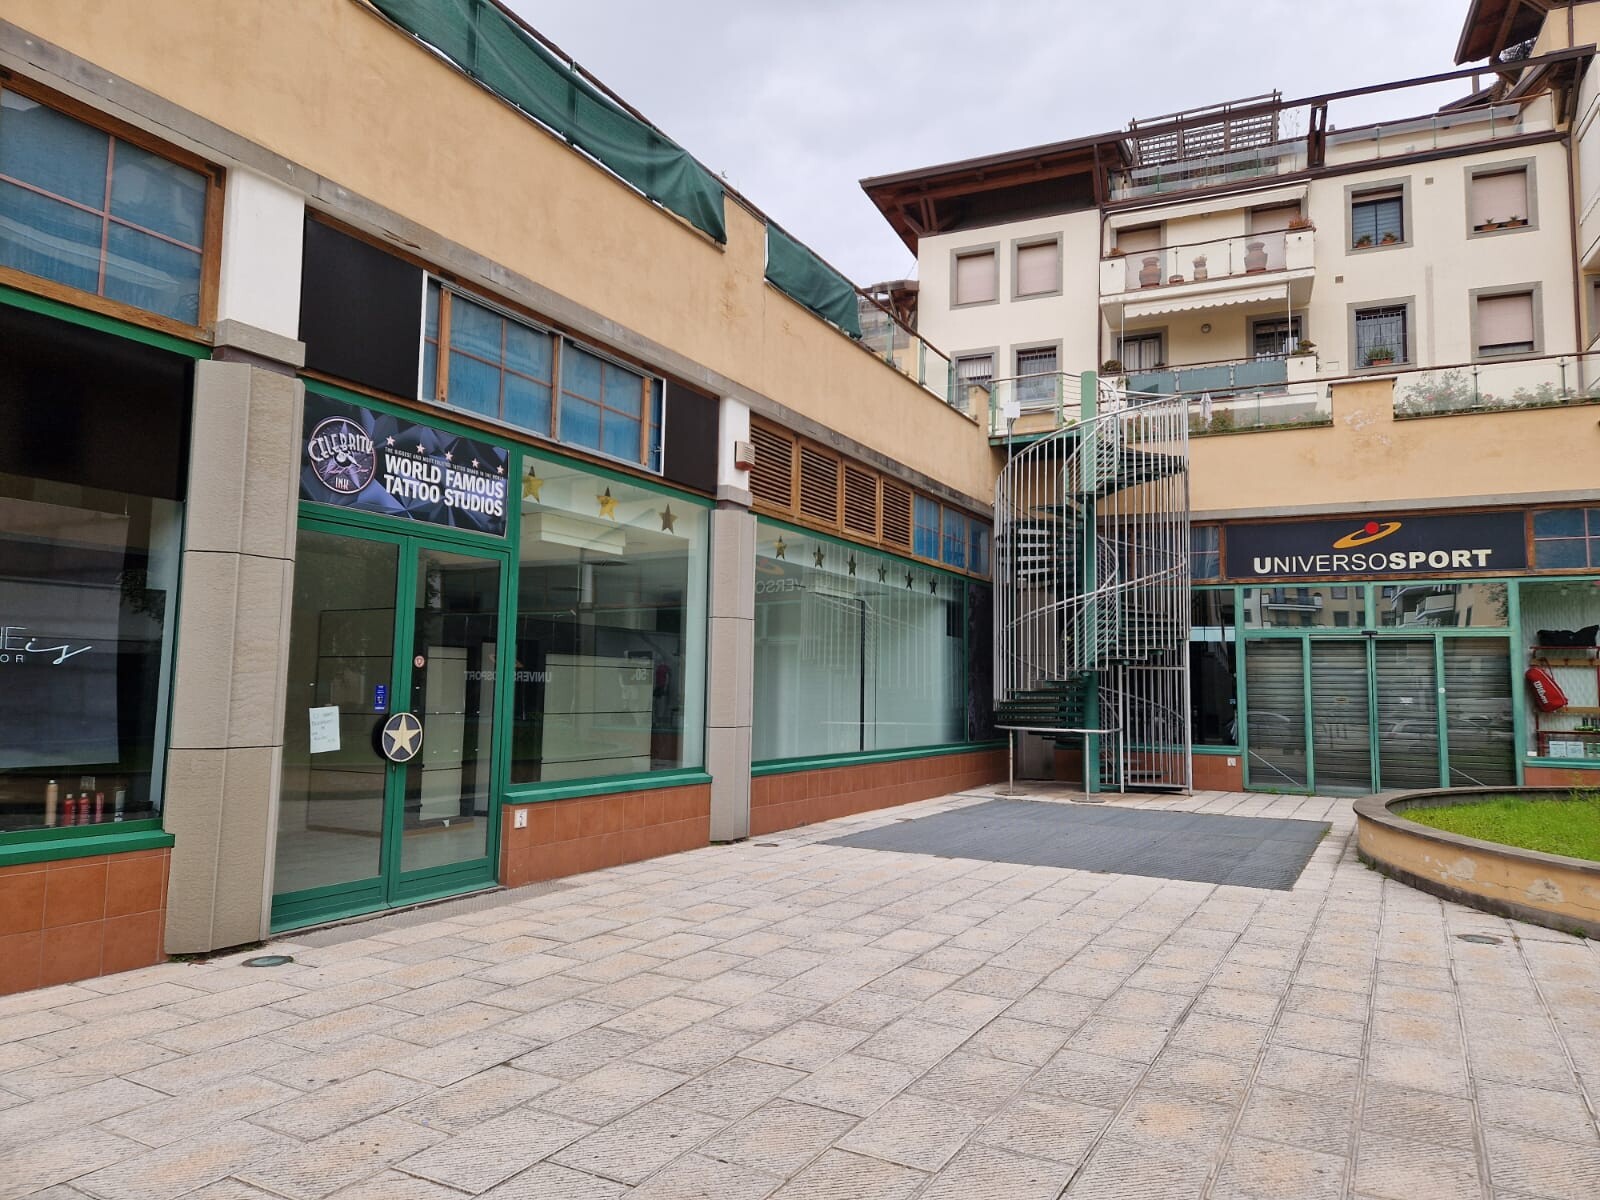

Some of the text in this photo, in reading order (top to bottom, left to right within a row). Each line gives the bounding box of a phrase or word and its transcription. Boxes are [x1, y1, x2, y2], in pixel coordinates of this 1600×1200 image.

[307, 432, 374, 461] CELEBRITY
[335, 476, 350, 491] INK
[384, 454, 504, 499] WORLD FAMOUS
[383, 474, 503, 517] TATTOO STUDIOS
[1253, 549, 1493, 574] UNIVERSOSPORT
